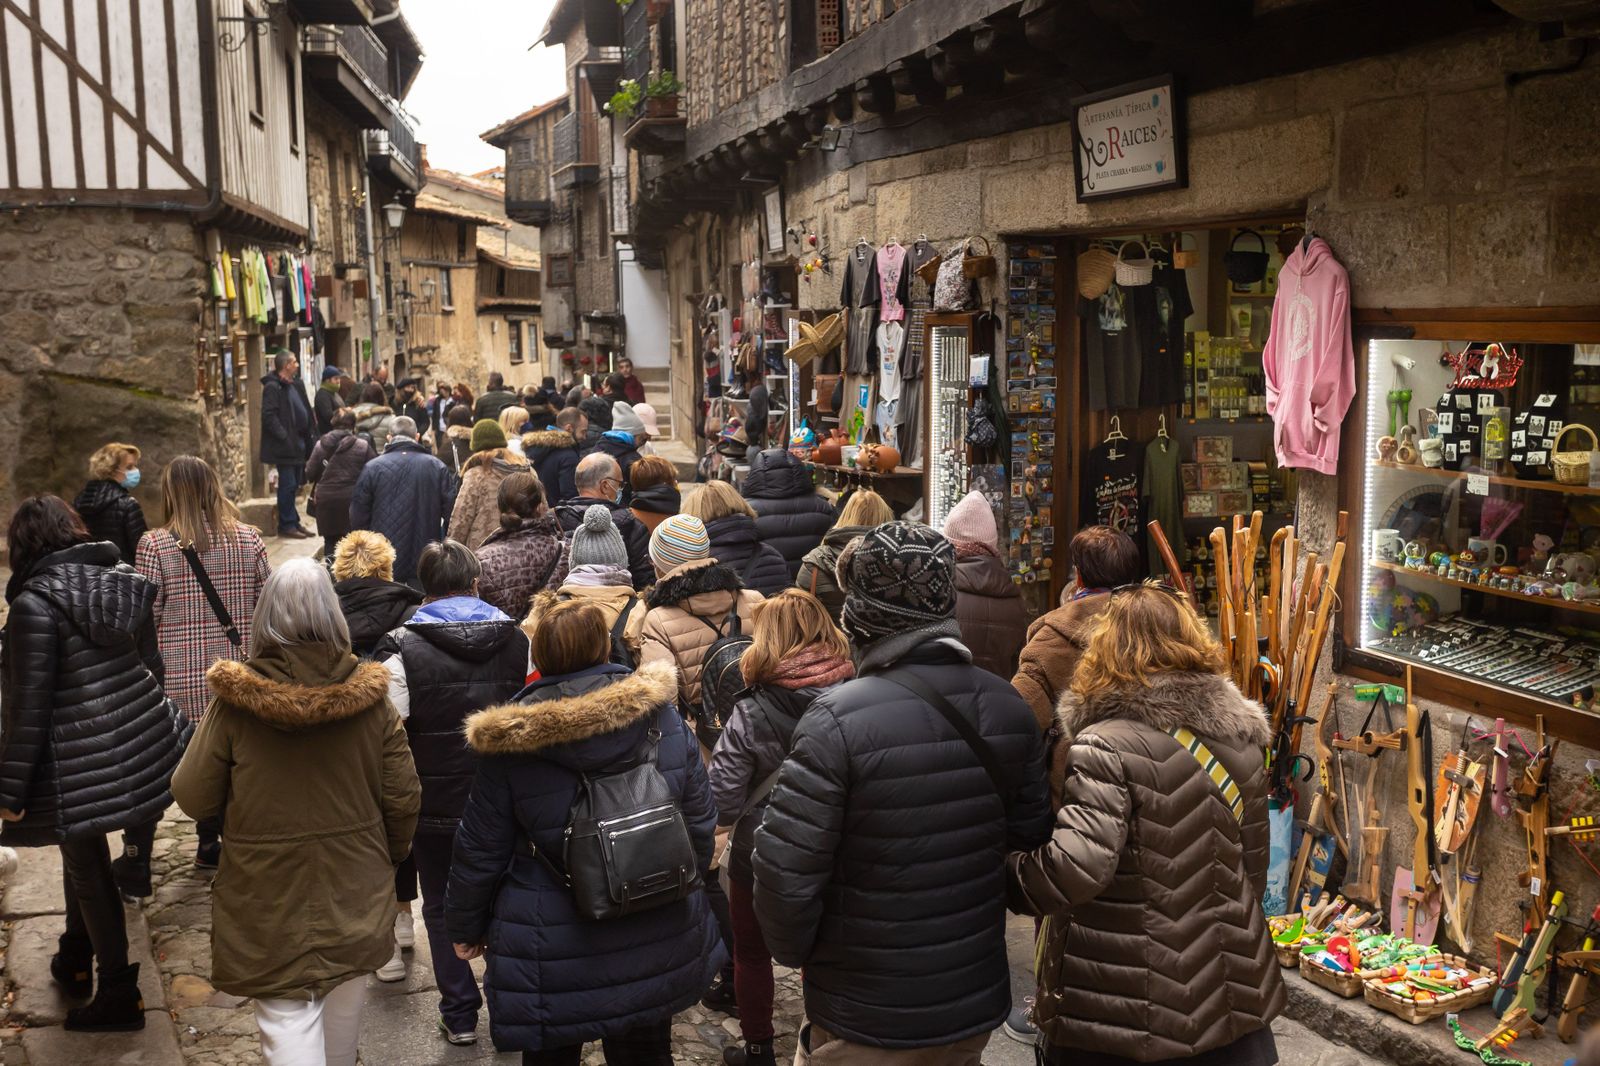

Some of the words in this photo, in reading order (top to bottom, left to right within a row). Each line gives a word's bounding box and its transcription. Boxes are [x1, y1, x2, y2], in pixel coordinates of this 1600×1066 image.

[1084, 108, 1123, 126] ARTESANÍA
[1126, 102, 1152, 117] TÍPICA
[1106, 126, 1158, 160] RAICES
